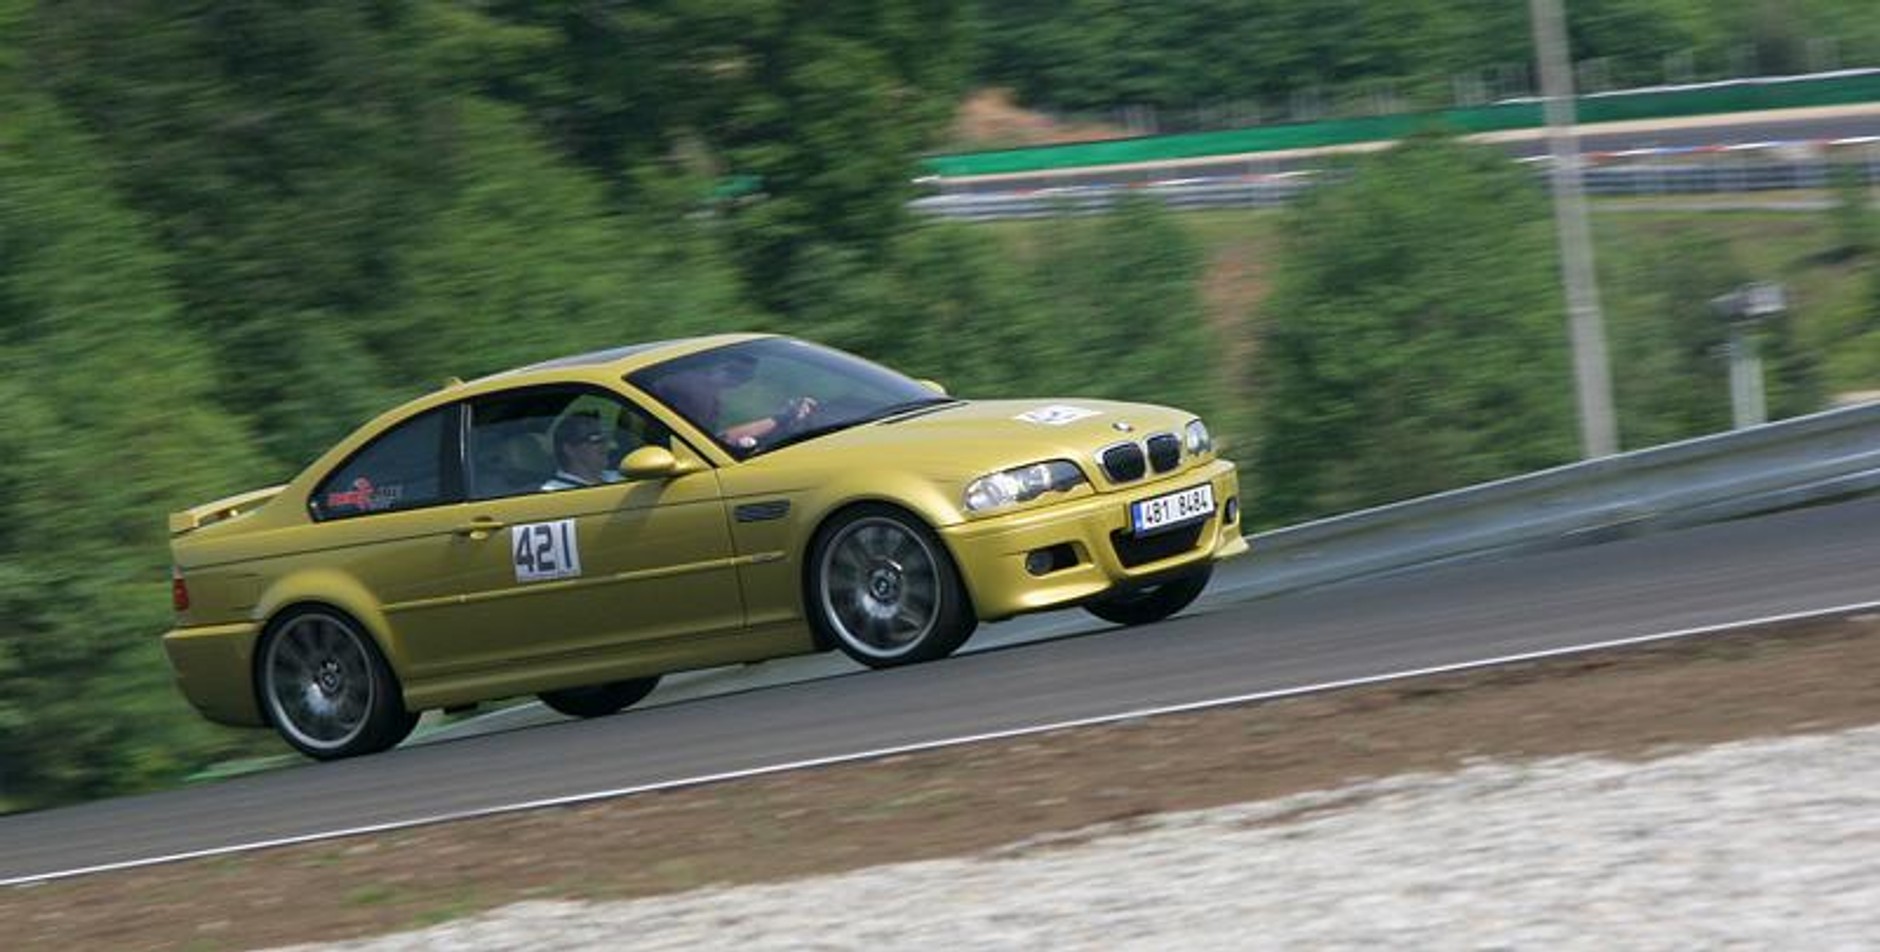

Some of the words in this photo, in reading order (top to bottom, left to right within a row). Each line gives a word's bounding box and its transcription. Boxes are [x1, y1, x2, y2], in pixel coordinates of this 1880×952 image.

[1145, 499, 1170, 524] 4B1
[1178, 489, 1208, 516] 8484
[515, 522, 572, 573] 421
